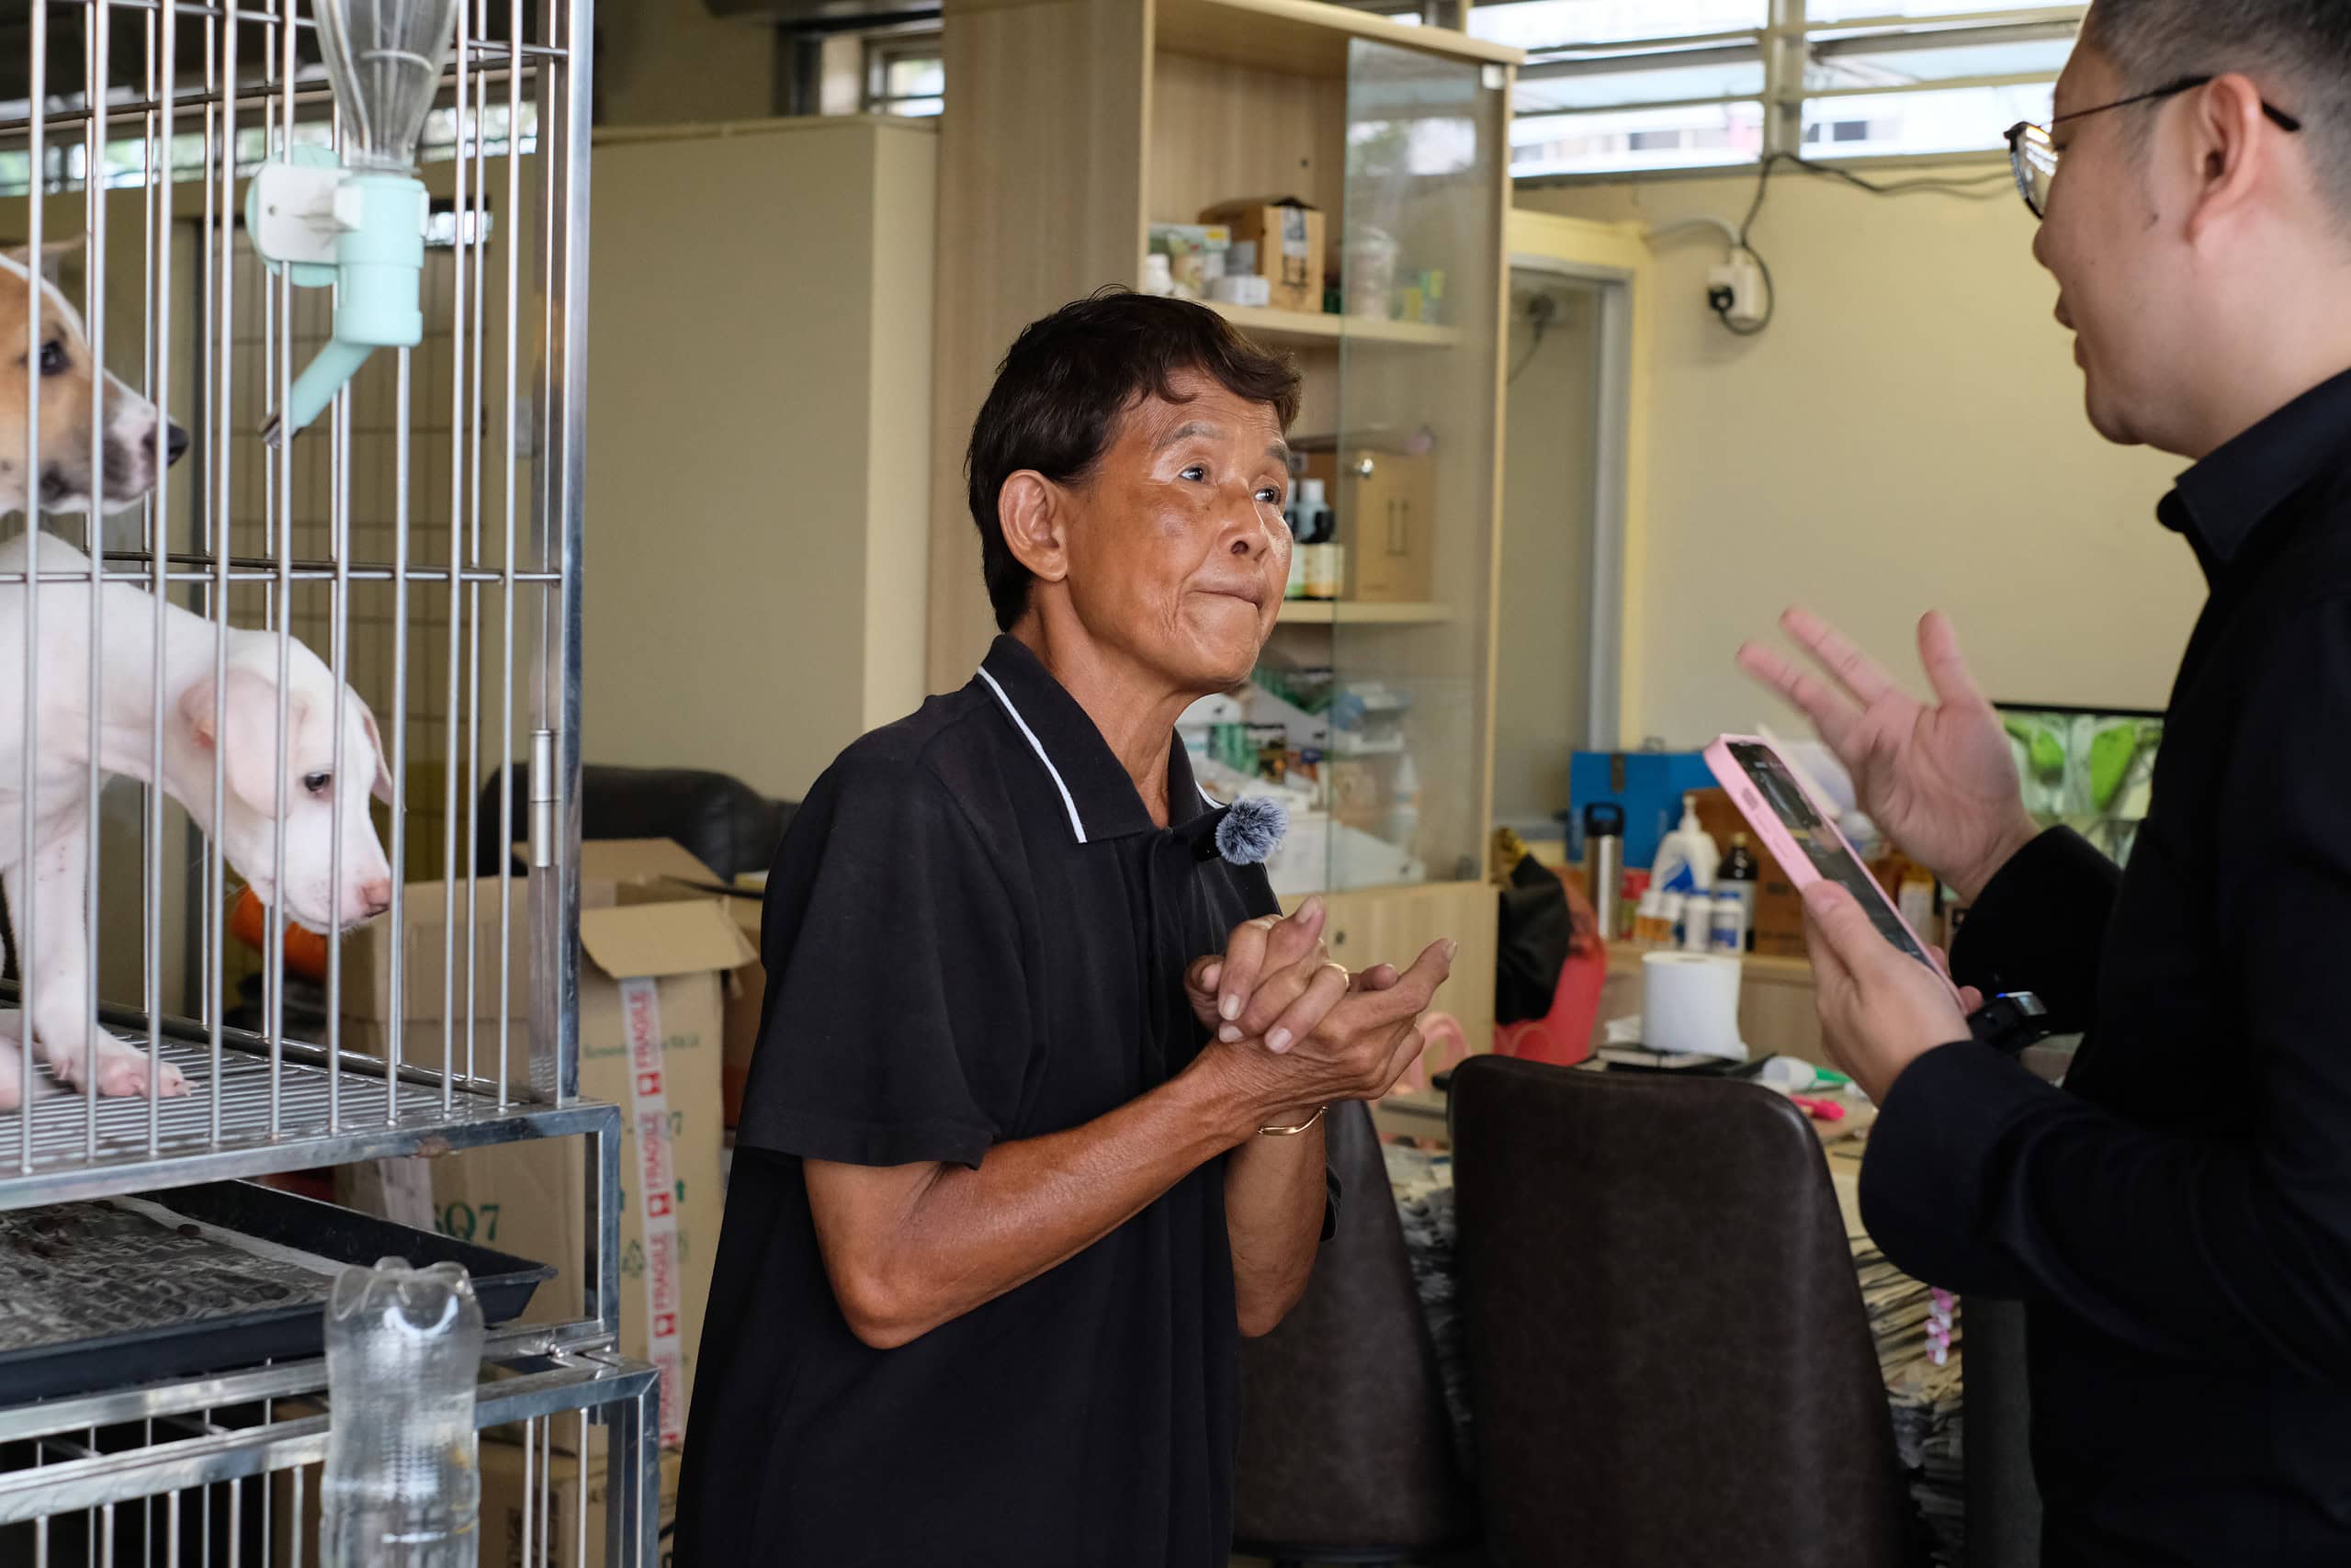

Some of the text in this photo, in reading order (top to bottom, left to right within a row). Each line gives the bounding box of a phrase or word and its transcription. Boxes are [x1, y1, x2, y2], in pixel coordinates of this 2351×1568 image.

[631, 991, 651, 1069] FRAGILE
[642, 1112, 662, 1189] FRAGILE
[651, 1234, 671, 1310] FRAGILE
